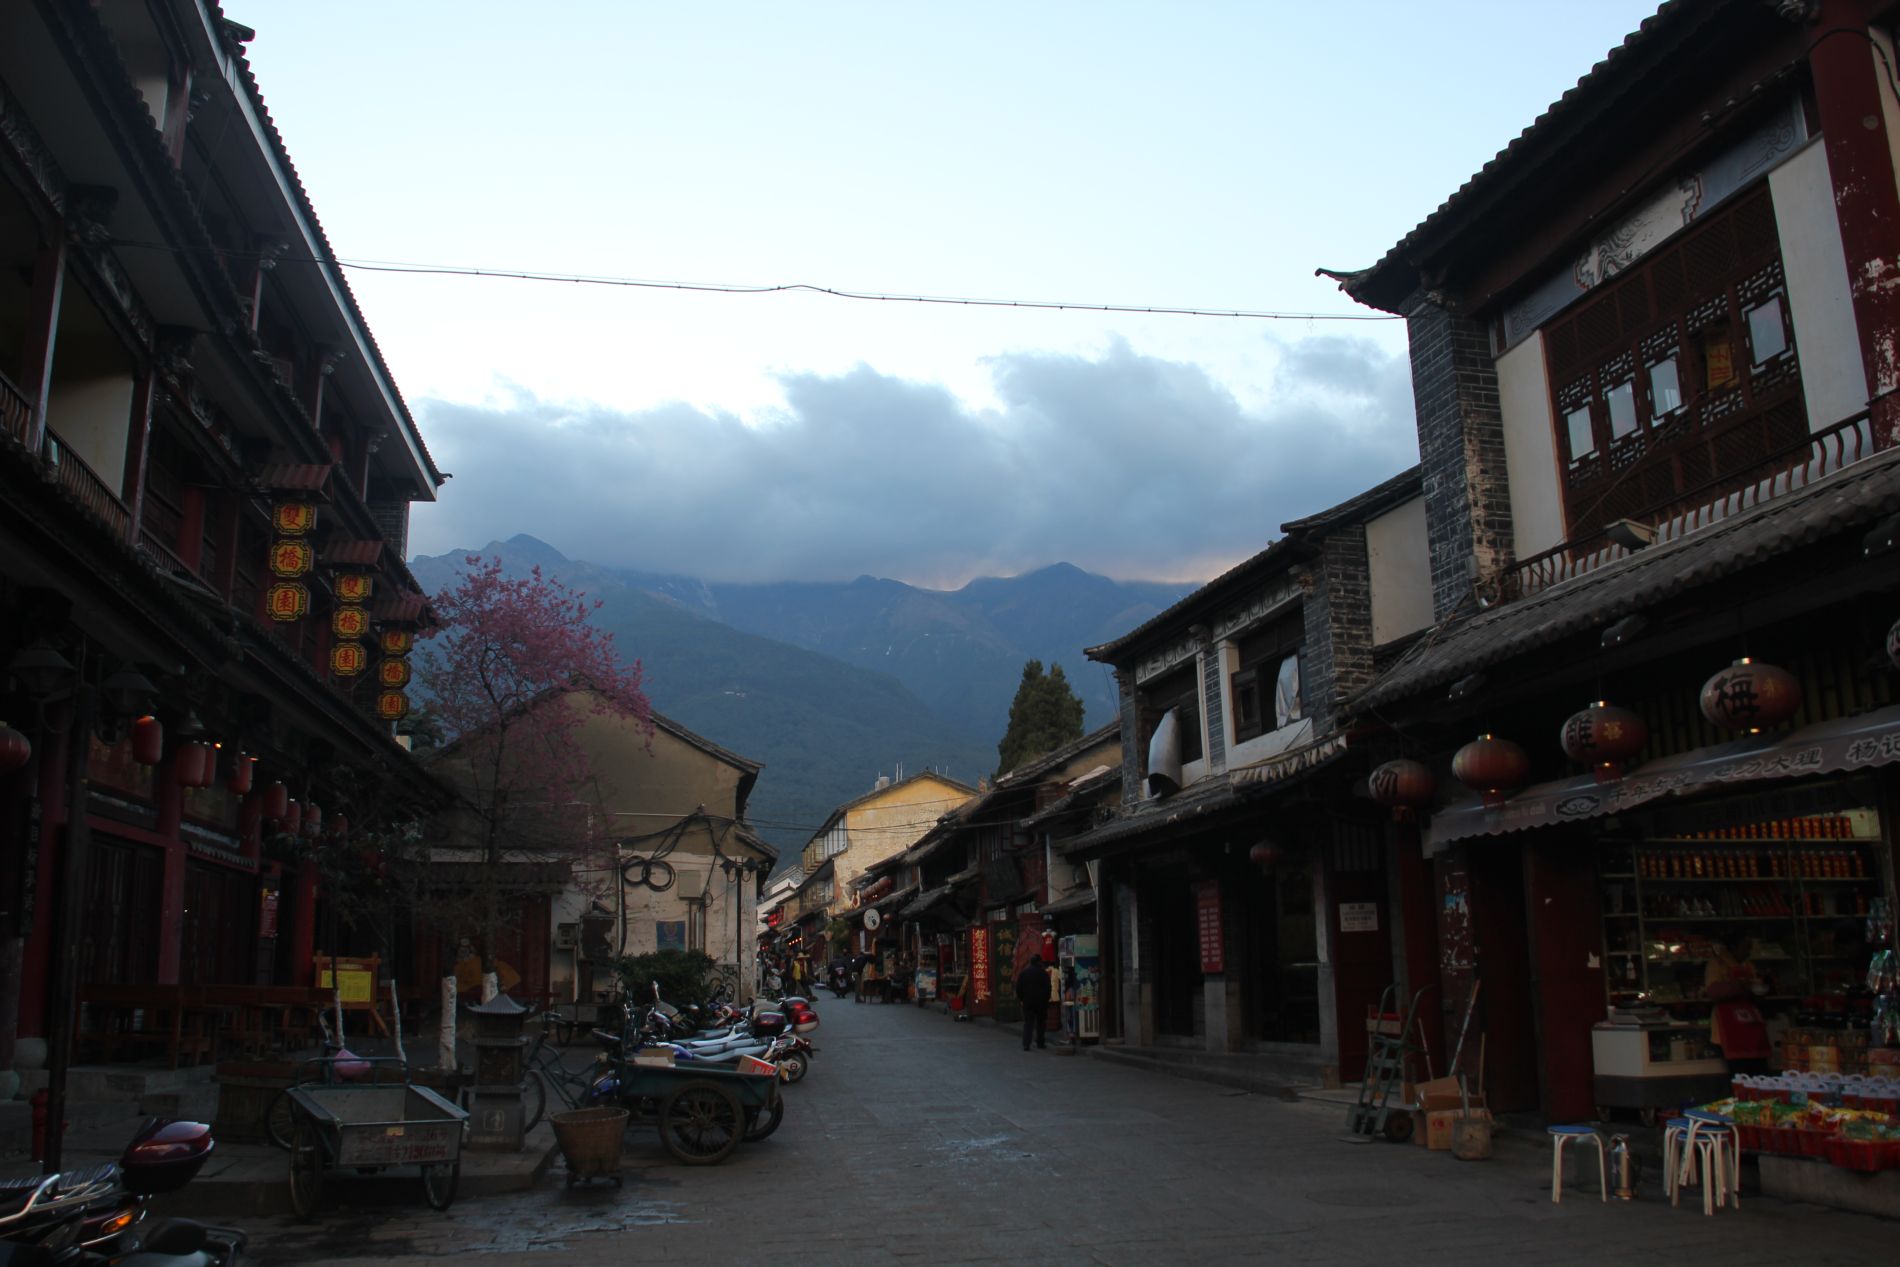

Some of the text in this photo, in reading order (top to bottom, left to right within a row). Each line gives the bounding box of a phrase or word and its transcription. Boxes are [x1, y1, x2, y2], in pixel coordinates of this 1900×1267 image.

[275, 503, 303, 613] 雙橋園
[338, 575, 360, 669] 雙橋園
[384, 631, 404, 713] 雙橋園
[1714, 673, 1760, 721] 梅
